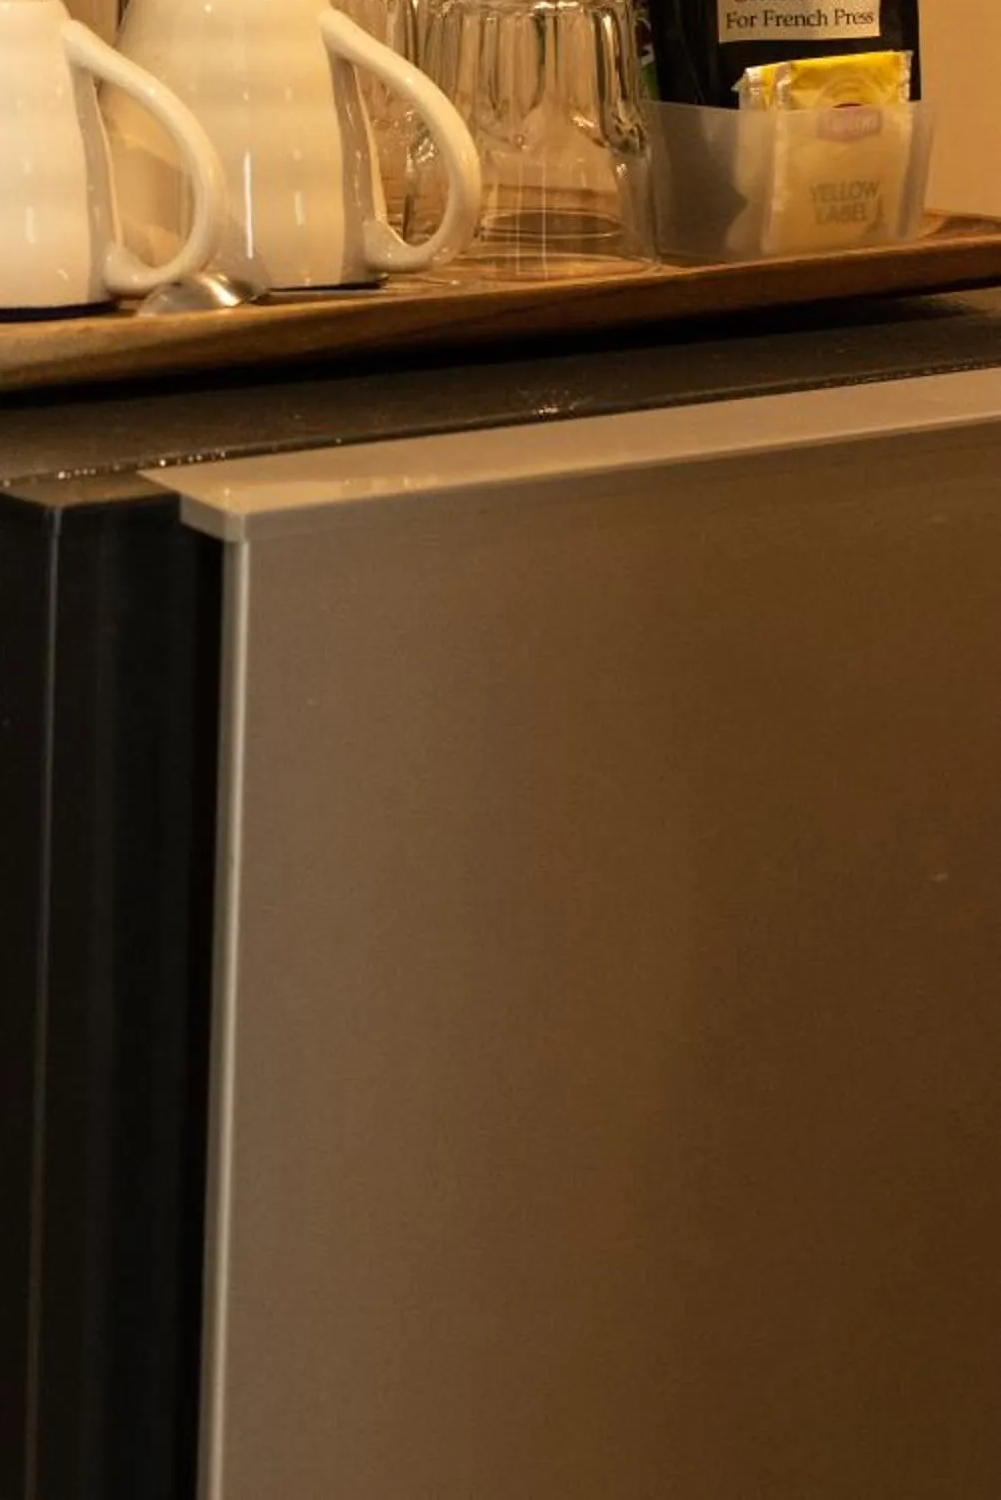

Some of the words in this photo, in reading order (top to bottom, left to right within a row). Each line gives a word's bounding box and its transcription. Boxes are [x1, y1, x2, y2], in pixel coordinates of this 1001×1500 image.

[726, 11, 757, 29] For
[762, 9, 828, 28] French
[834, 8, 874, 25] Press
[809, 180, 880, 202] YELLOW
[814, 201, 872, 225] LABEL
